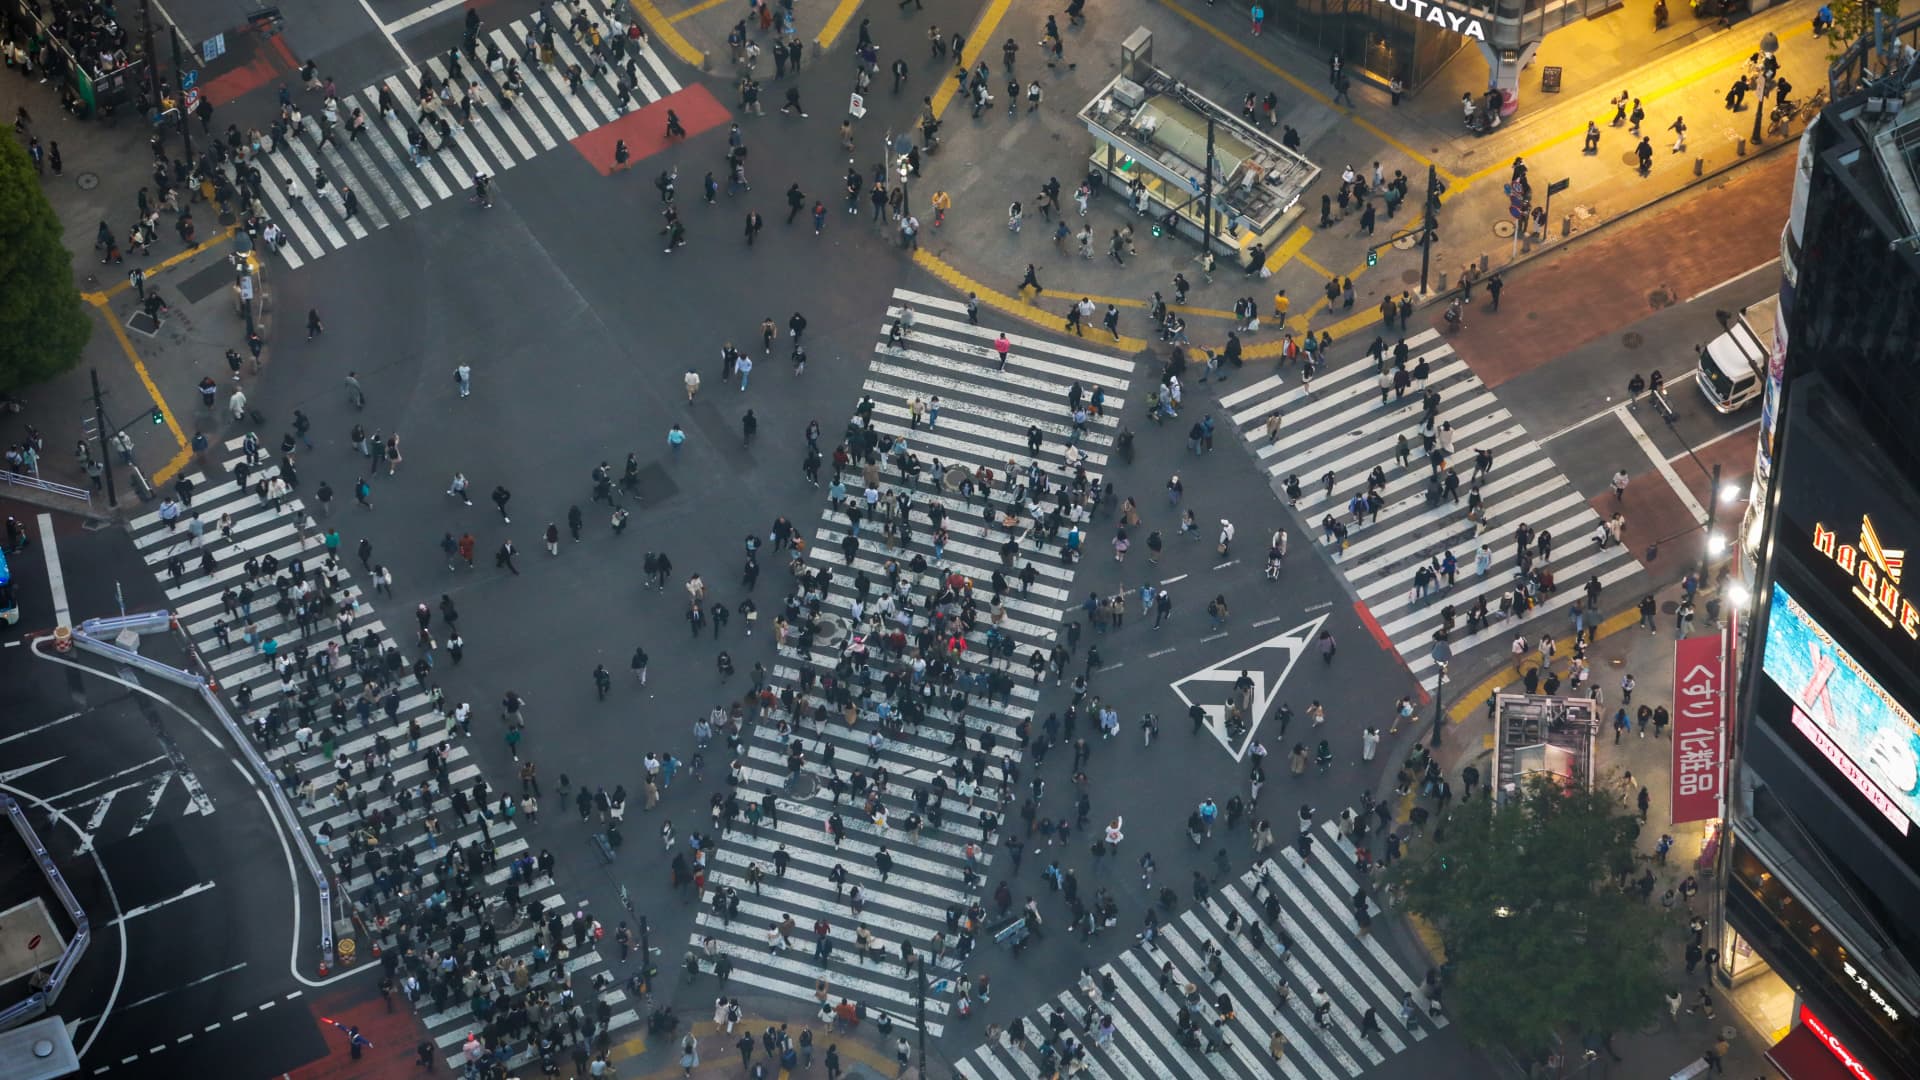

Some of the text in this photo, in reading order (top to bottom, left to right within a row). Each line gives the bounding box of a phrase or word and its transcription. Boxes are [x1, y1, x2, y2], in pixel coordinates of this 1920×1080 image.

[1378, 0, 1485, 41] UTAYA
[1681, 664, 1715, 719] くすり
[1679, 727, 1715, 796] 化粧品
